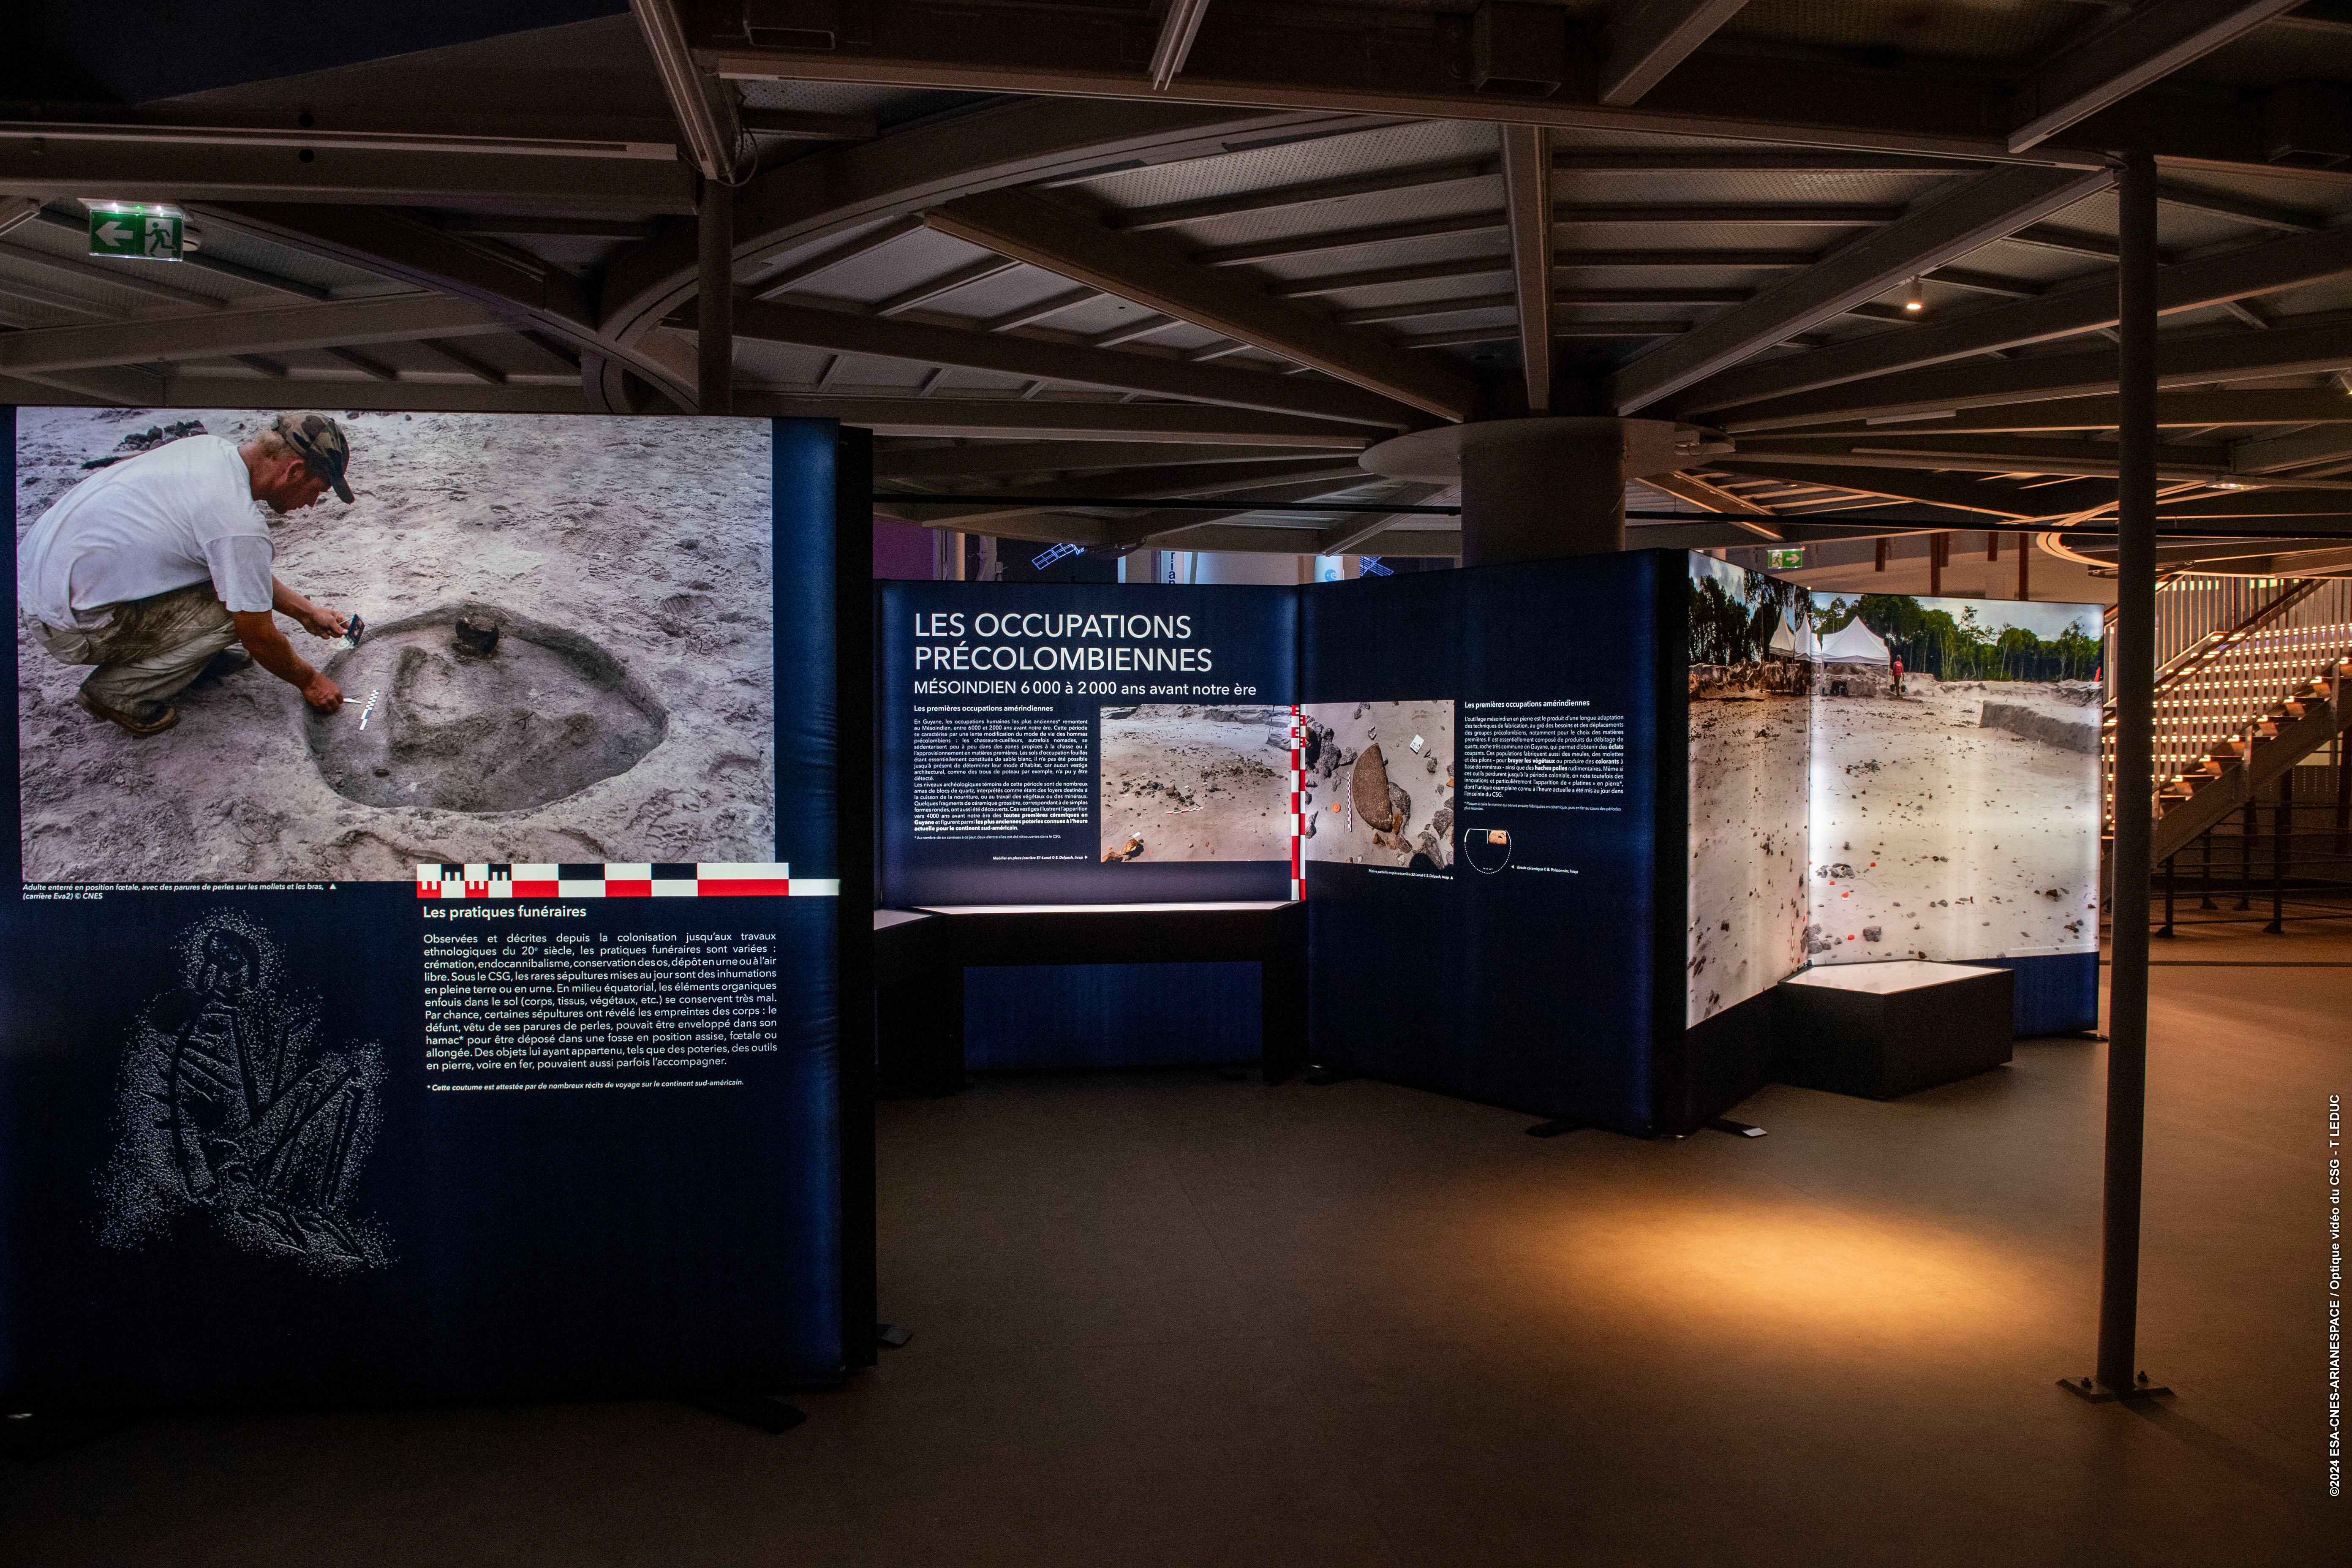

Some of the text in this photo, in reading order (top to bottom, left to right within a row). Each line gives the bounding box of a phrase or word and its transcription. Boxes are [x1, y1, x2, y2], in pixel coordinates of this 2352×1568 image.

[916, 613, 1190, 639] LES OCCUPATIONS
[916, 641, 1211, 672] PRÉCOLOMBIENNES
[915, 678, 1015, 694] MÉSOINDIEN
[1065, 682, 1073, 694] à
[1122, 686, 1145, 694] ans
[1150, 684, 1188, 694] avant
[1193, 684, 1229, 695] notre
[1234, 683, 1256, 695] ère
[1476, 701, 1504, 710] premières
[1506, 700, 1541, 709] occupations
[423, 905, 586, 920] Les pratiques funéraires
[424, 934, 477, 943] Observées
[507, 934, 547, 942] décrites
[556, 933, 590, 944] depuis
[600, 933, 607, 942] la
[618, 933, 676, 941] colonisation
[424, 947, 496, 958] ethnologiques
[503, 946, 515, 955] du
[544, 946, 574, 956] siècle,
[581, 946, 594, 954] les
[601, 946, 646, 956] pratiques
[652, 945, 700, 953] funéraires
[733, 945, 767, 953] variées
[440, 985, 471, 996] pleine
[558, 984, 569, 992] En
[572, 983, 601, 992] milieu
[604, 983, 656, 994] équatorial,
[659, 983, 672, 991] les
[675, 982, 719, 991] éléments
[722, 982, 776, 992] organiques
[442, 1061, 474, 1072] pierre,
[476, 1060, 501, 1069] voire
[519, 1059, 534, 1069] fer,
[538, 1059, 587, 1070] pouvaient
[590, 1059, 613, 1067] aussi
[617, 1057, 650, 1069] parfois
